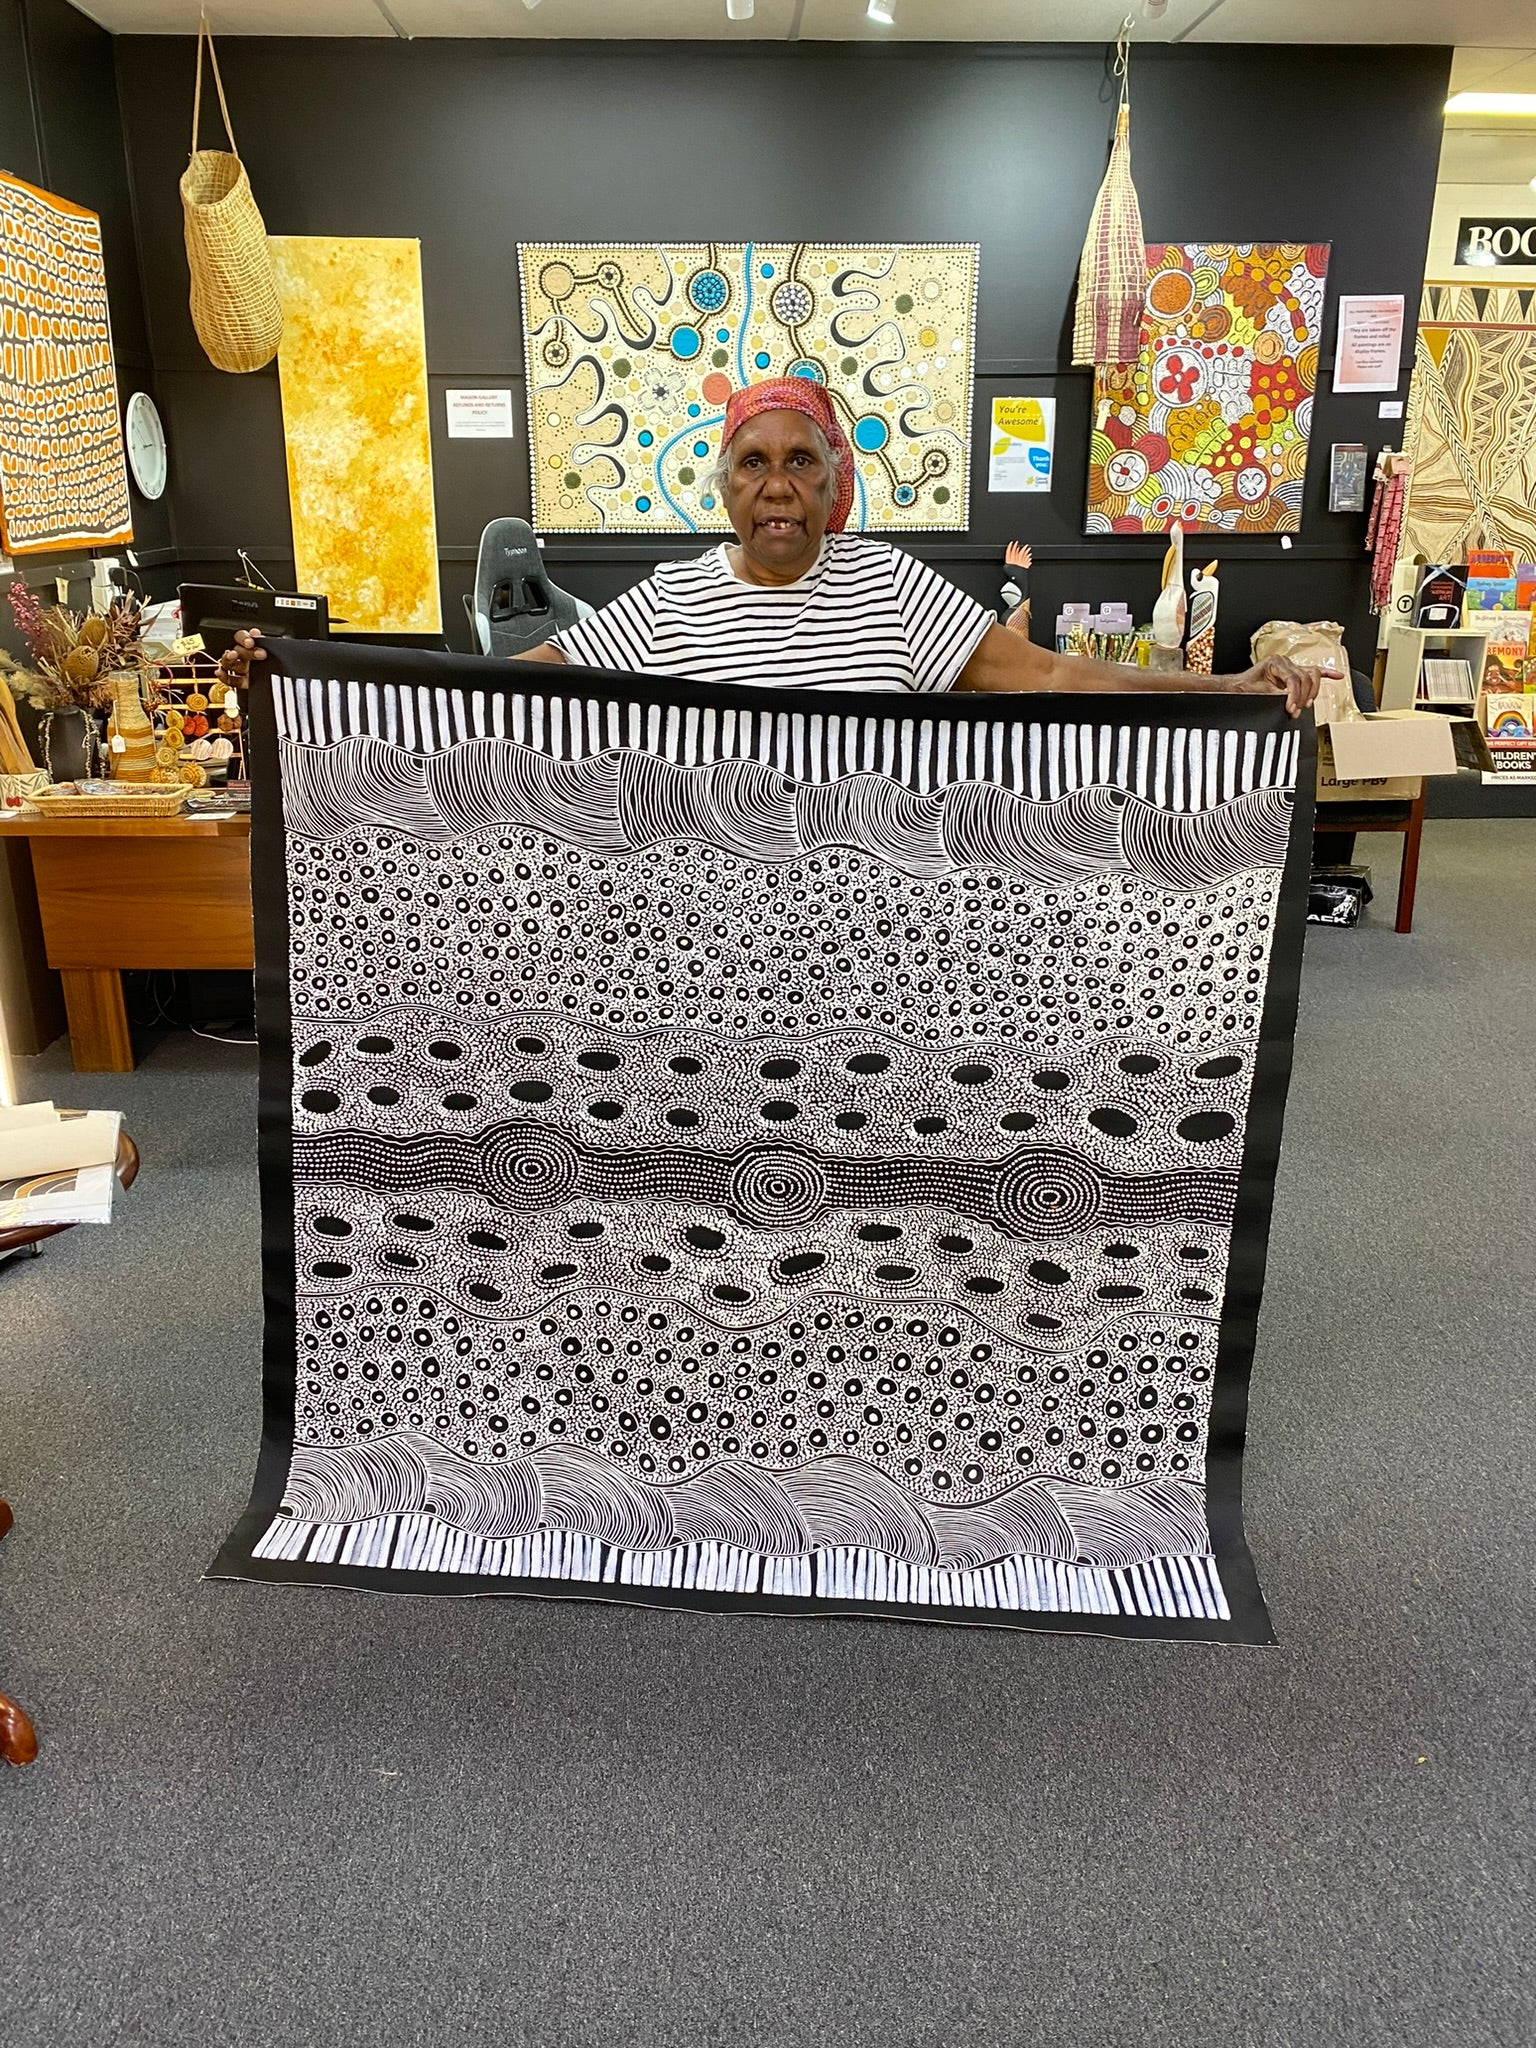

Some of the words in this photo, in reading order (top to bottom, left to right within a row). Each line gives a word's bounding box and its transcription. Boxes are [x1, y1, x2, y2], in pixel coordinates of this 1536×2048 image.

[999, 405, 1027, 414] You're
[998, 417, 1039, 426] Awesome
[1487, 646, 1524, 656] REMONY
[1491, 751, 1536, 761] HILDREN'
[1496, 760, 1532, 769] BOOKS
[1321, 776, 1360, 788] Large
[1306, 914, 1347, 924] ACK
